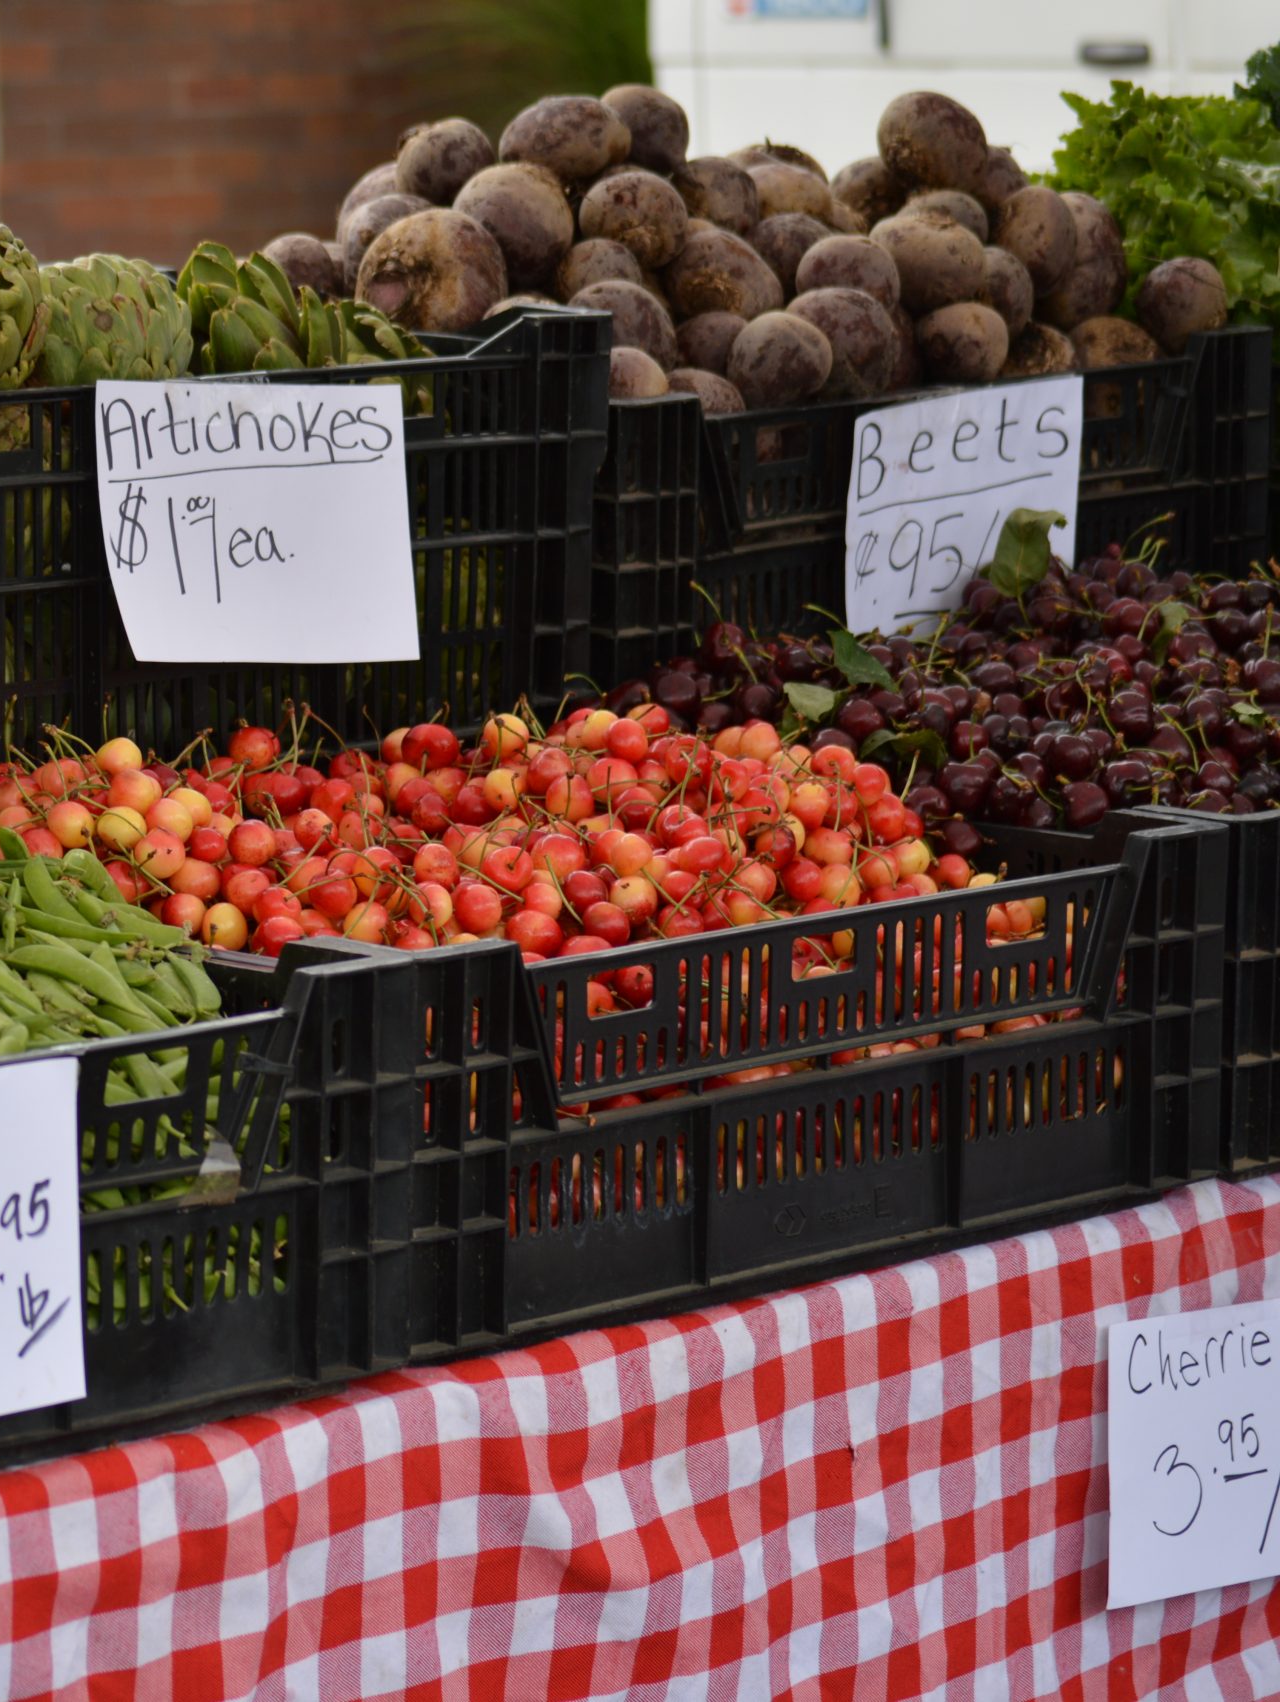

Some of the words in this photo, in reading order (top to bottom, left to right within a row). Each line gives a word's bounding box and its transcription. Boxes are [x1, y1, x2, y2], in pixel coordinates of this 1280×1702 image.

[100, 391, 392, 471] Artichokes
[857, 398, 1070, 502] Beets
[1127, 1322, 1272, 1395] Cherrie
